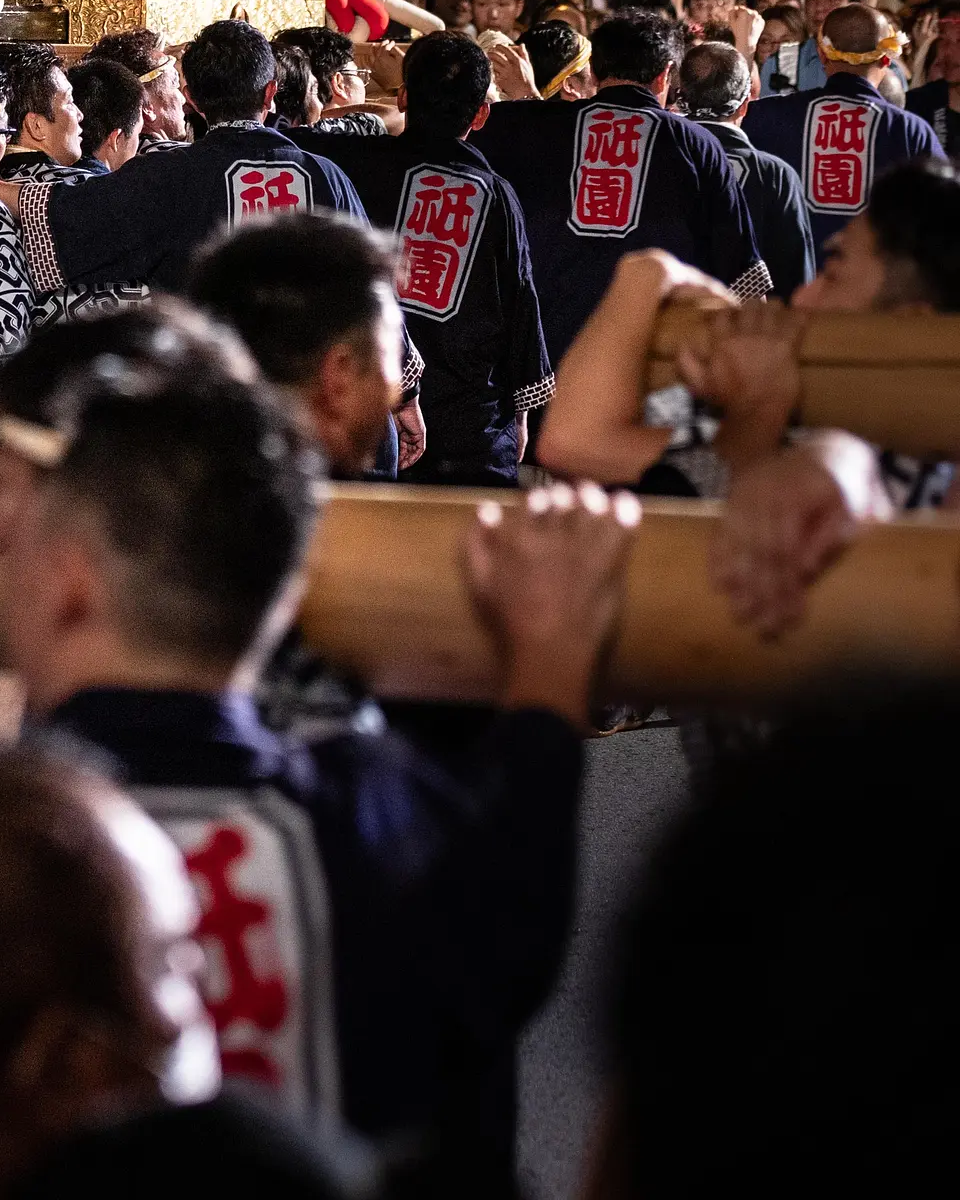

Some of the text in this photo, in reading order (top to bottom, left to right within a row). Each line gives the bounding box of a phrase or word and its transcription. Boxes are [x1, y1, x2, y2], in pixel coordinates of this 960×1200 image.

[577, 110, 645, 227] 祇園
[813, 103, 868, 205] 祇園
[397, 175, 477, 310] 祇園
